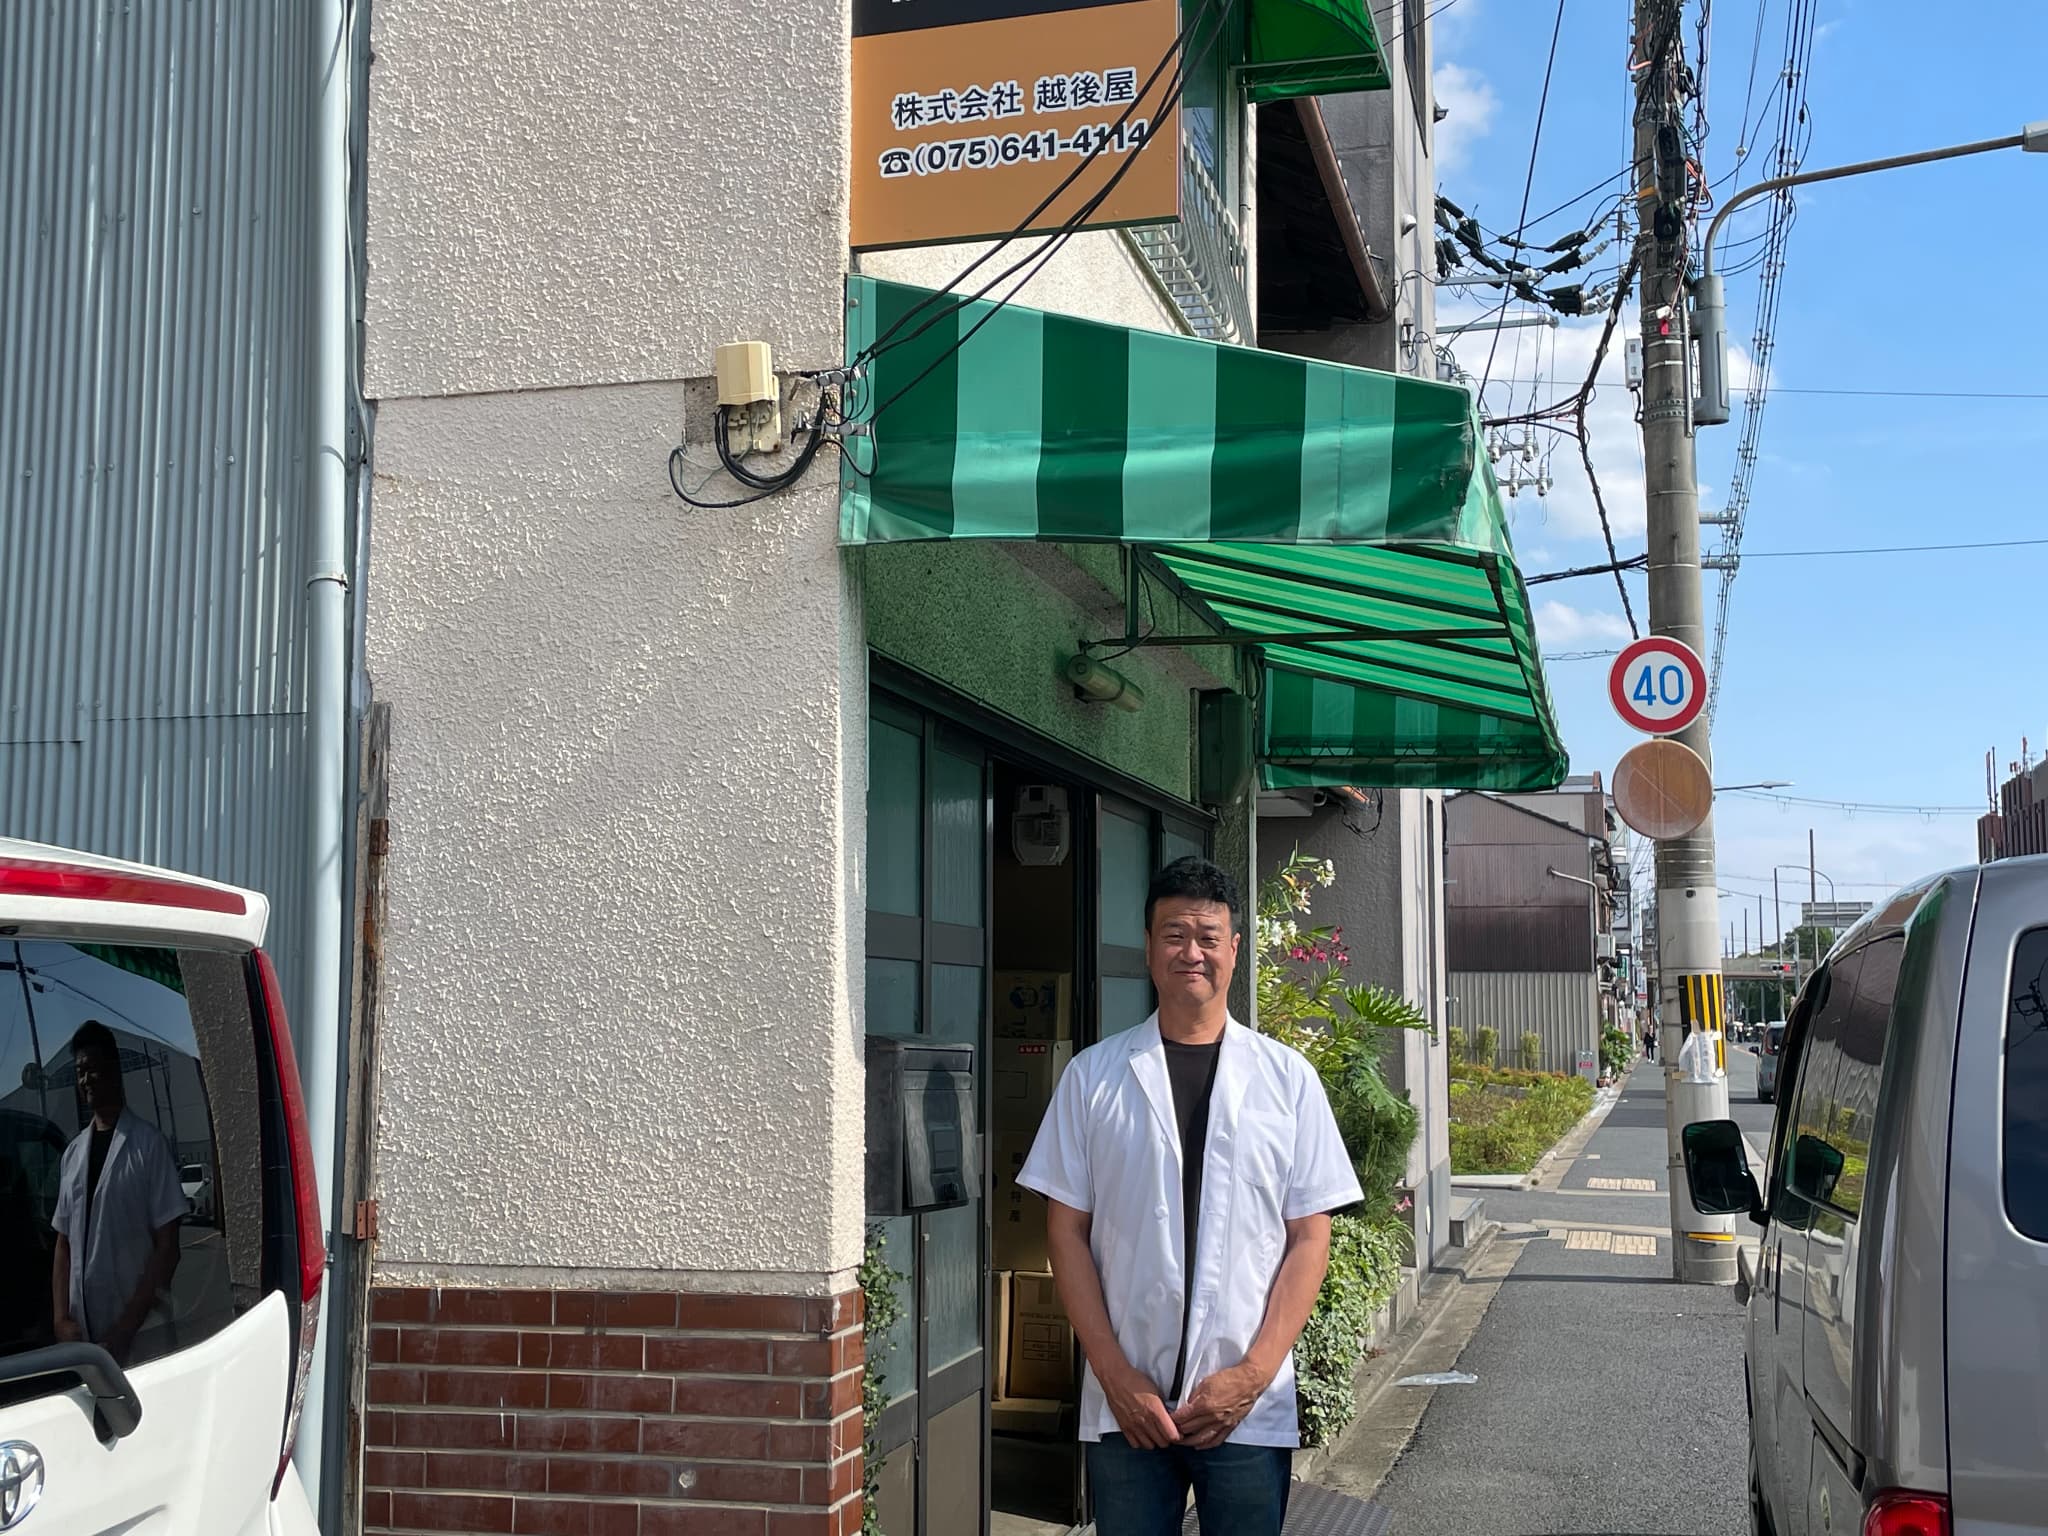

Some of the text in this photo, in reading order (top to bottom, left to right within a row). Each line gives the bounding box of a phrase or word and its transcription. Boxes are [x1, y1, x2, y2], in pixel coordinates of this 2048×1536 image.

[894, 70, 1135, 128] 株式会社 越後屋
[1633, 665, 1685, 706] 40
